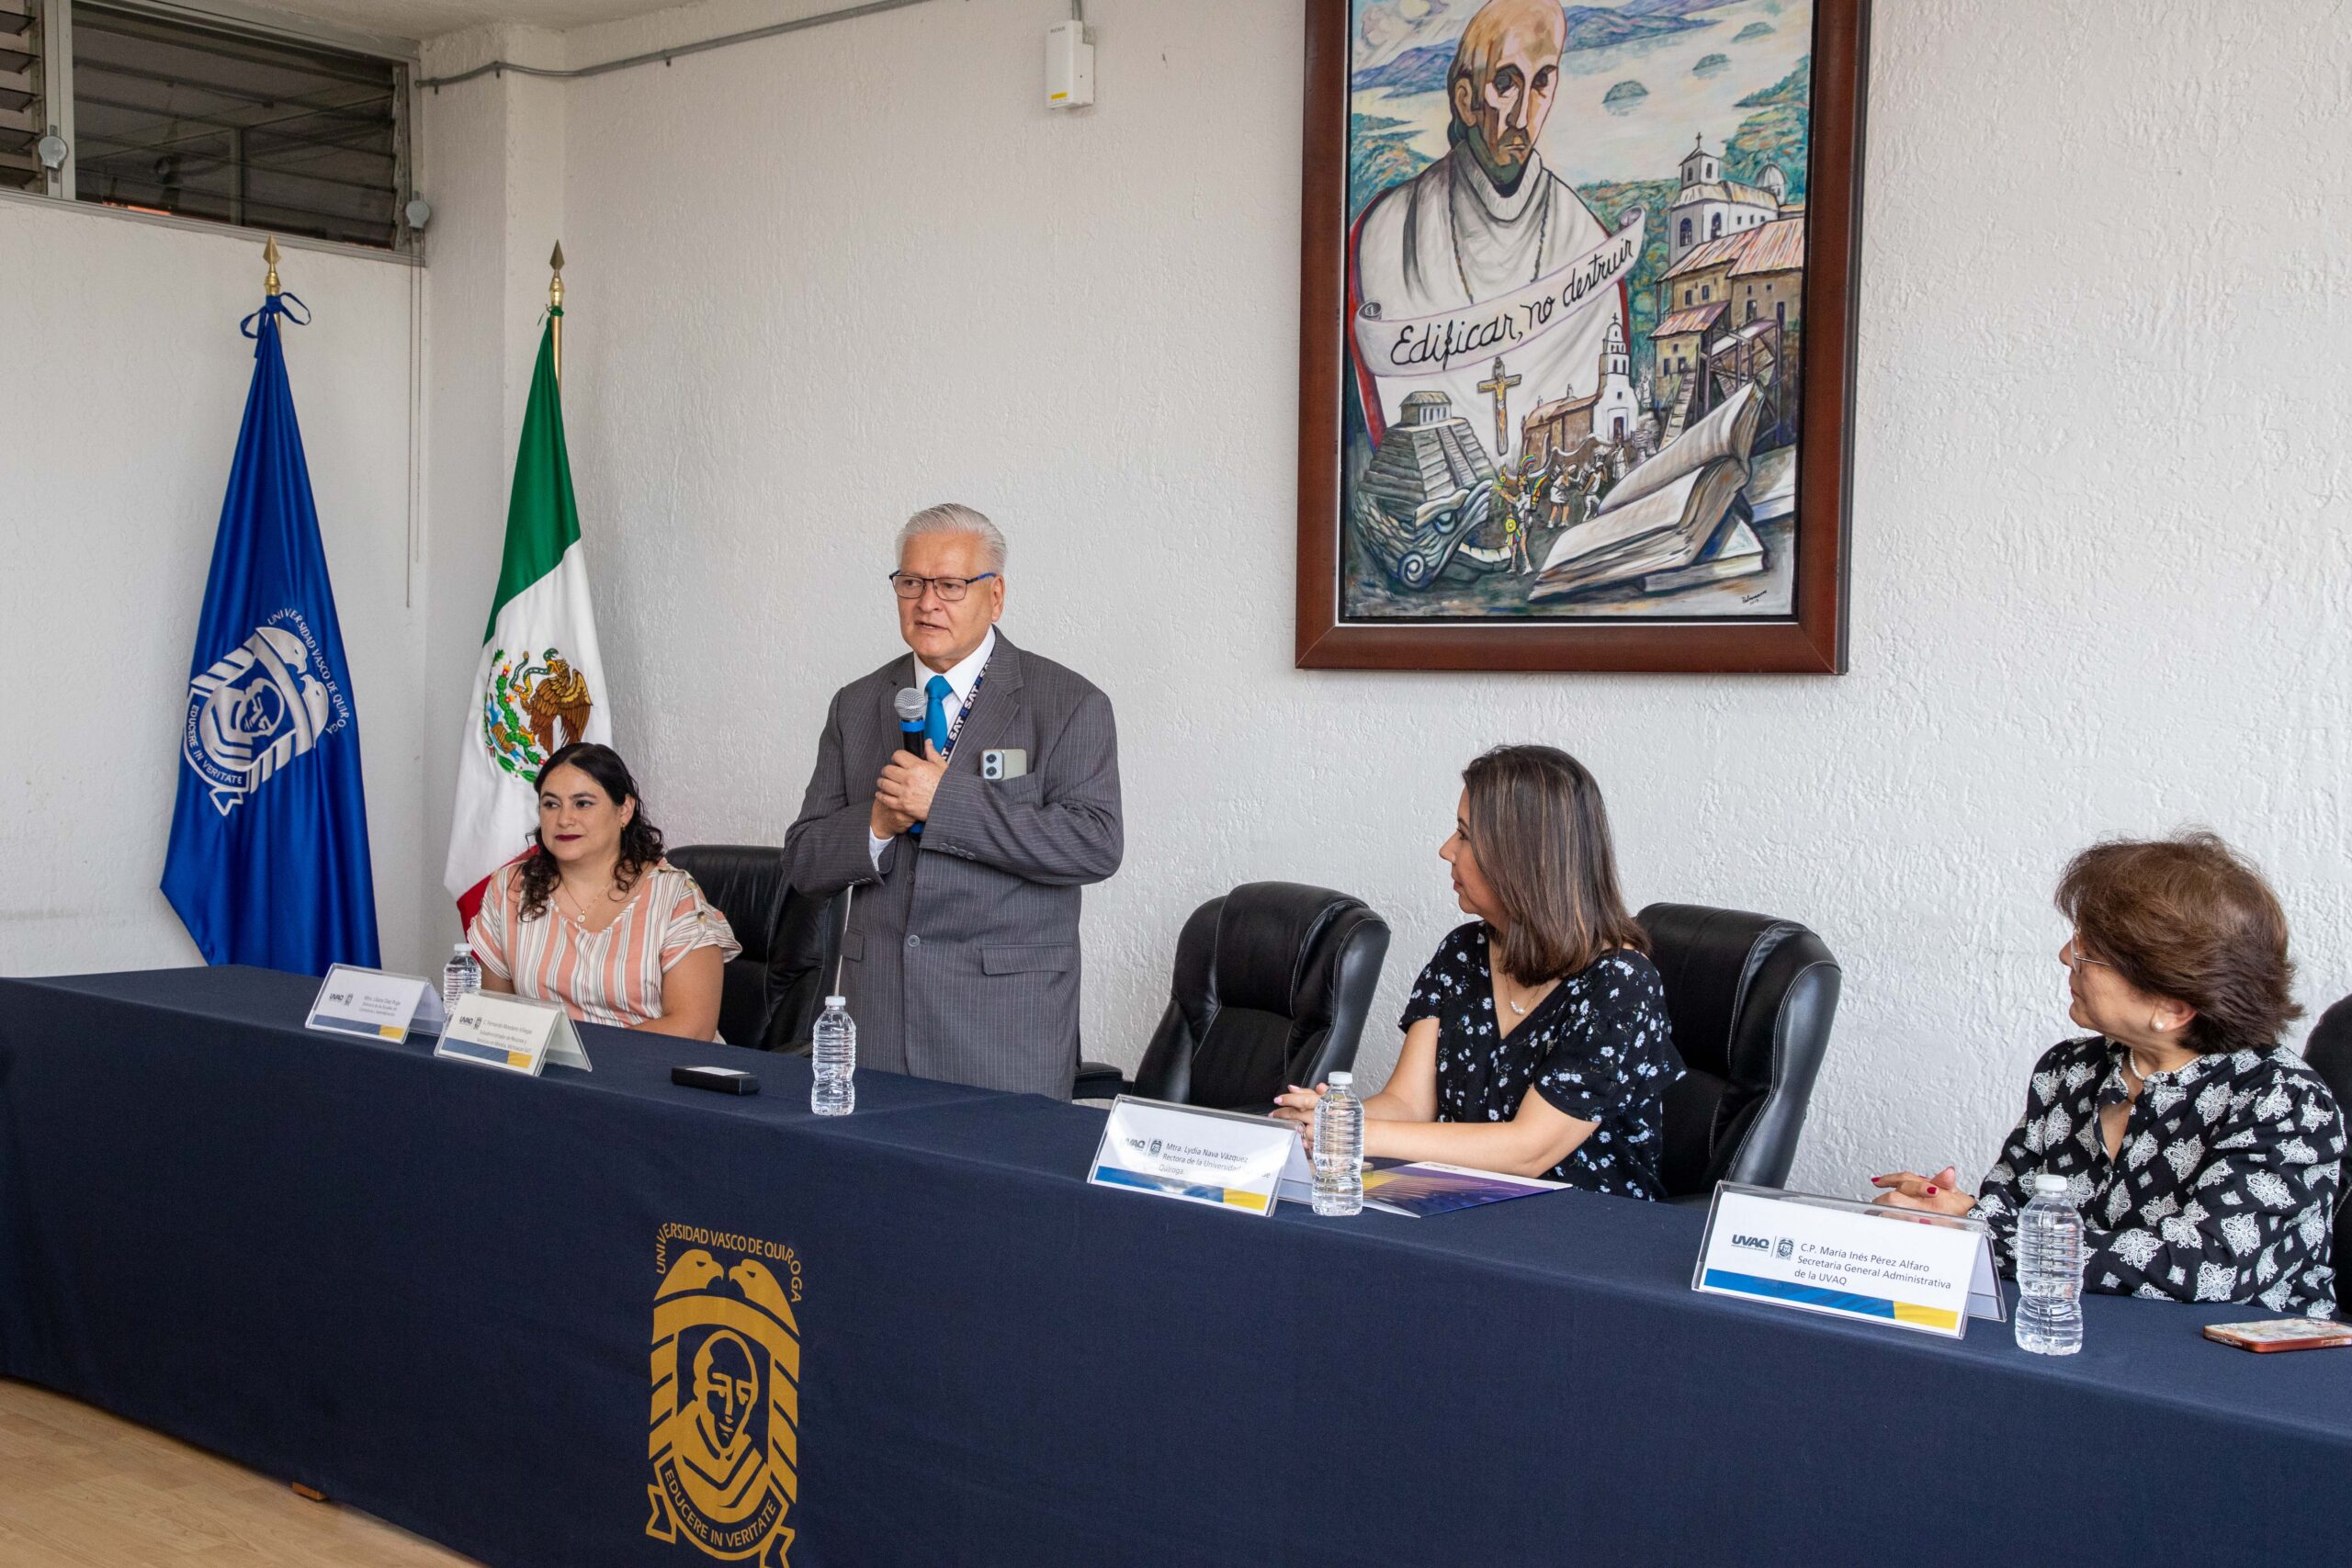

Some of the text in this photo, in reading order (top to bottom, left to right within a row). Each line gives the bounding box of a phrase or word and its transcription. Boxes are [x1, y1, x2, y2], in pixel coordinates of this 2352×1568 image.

[1390, 238, 1634, 371] Edificar, no destruir
[266, 607, 349, 734] UNIVERSIDAD VASCO DE QUIROGA
[965, 684, 979, 710] SAT
[949, 716, 965, 741] SAT
[187, 705, 243, 784] EDUCERE IN VERITATE
[1162, 1153, 1186, 1164] Rectora
[1186, 1156, 1195, 1165] de
[1196, 1157, 1203, 1166] la
[1166, 1143, 1182, 1152] Mtra.
[1184, 1145, 1202, 1156] Lydia
[1203, 1149, 1219, 1158] Nava
[1731, 1234, 1770, 1249] UVAQ
[656, 1223, 803, 1303] UNIVERSIDAD VASCO DE QUIROGA
[1797, 1255, 1951, 1290] Secretaria General Administrativa
[1801, 1243, 1930, 1273] C.P. María Inés Pérez Alfaro
[1794, 1269, 1848, 1286] de la UVAQ
[664, 1469, 776, 1547] EDUCERE IN VERITATE
